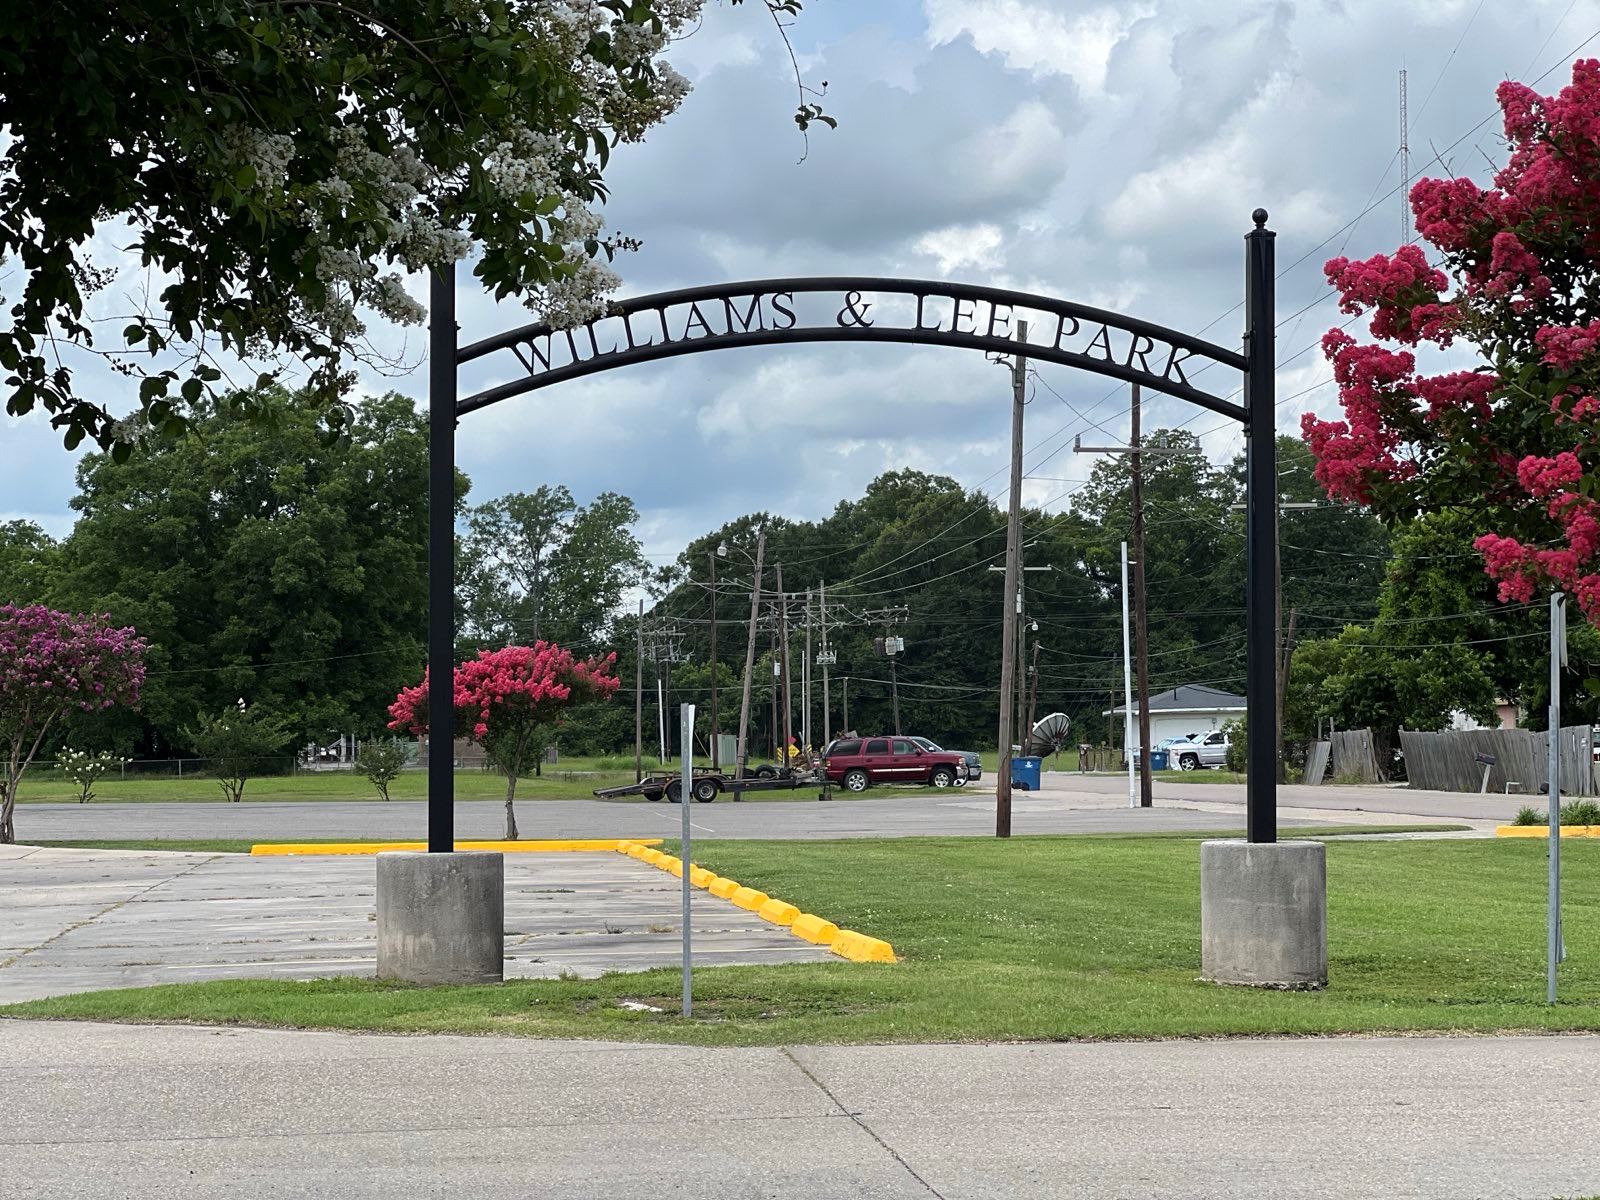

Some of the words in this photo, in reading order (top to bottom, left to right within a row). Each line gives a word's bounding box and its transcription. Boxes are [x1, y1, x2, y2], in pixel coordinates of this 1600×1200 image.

[506, 293, 797, 376] WILLIAMS
[837, 290, 875, 326] &
[912, 292, 1014, 338] LEE
[1050, 313, 1198, 386] PARK
